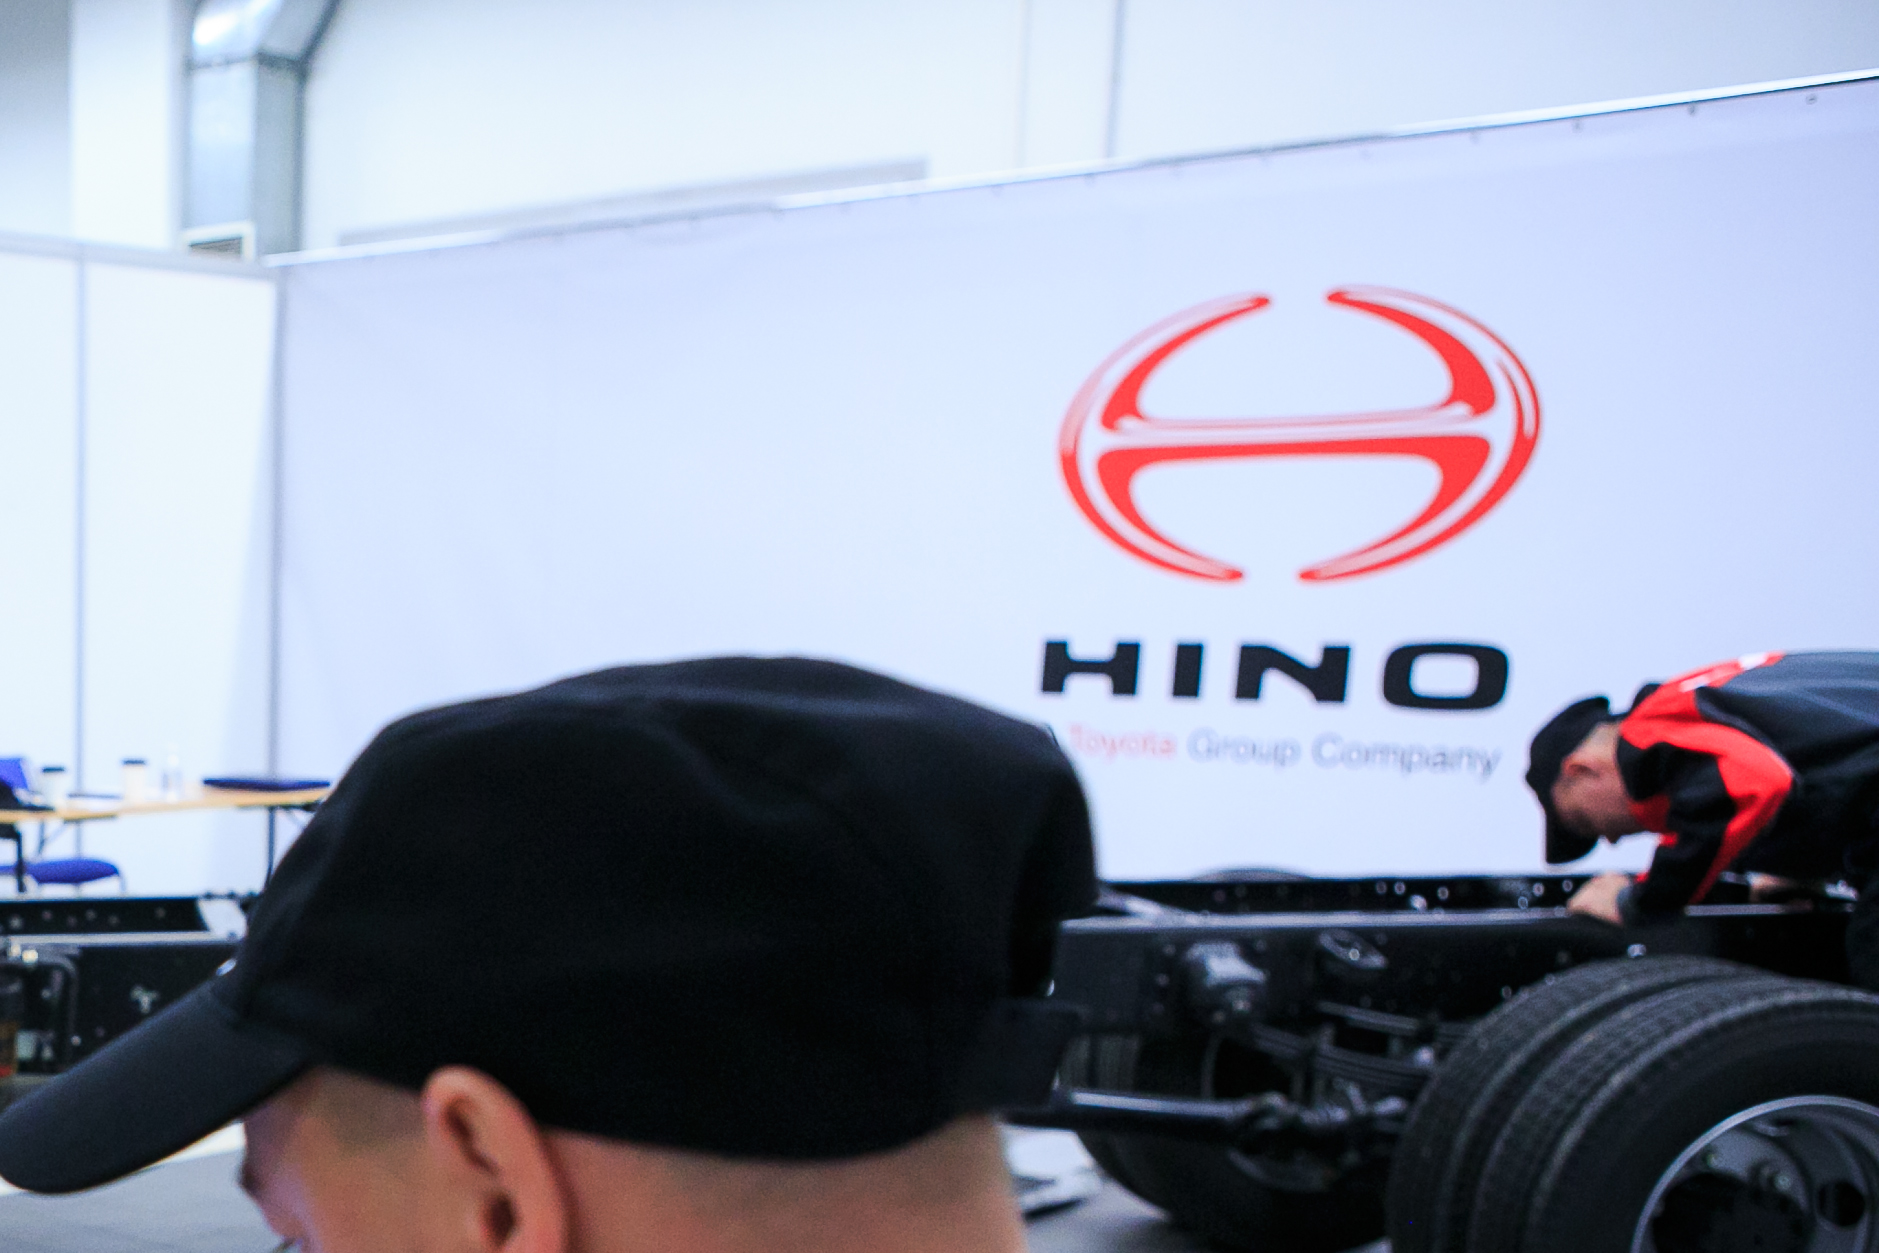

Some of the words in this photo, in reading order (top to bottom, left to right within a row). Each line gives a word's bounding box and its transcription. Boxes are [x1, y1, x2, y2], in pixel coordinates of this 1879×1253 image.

[1041, 641, 1510, 710] HINO
[1068, 724, 1175, 757] Toyota
[1187, 728, 1302, 766] Group
[1312, 731, 1502, 777] Company
